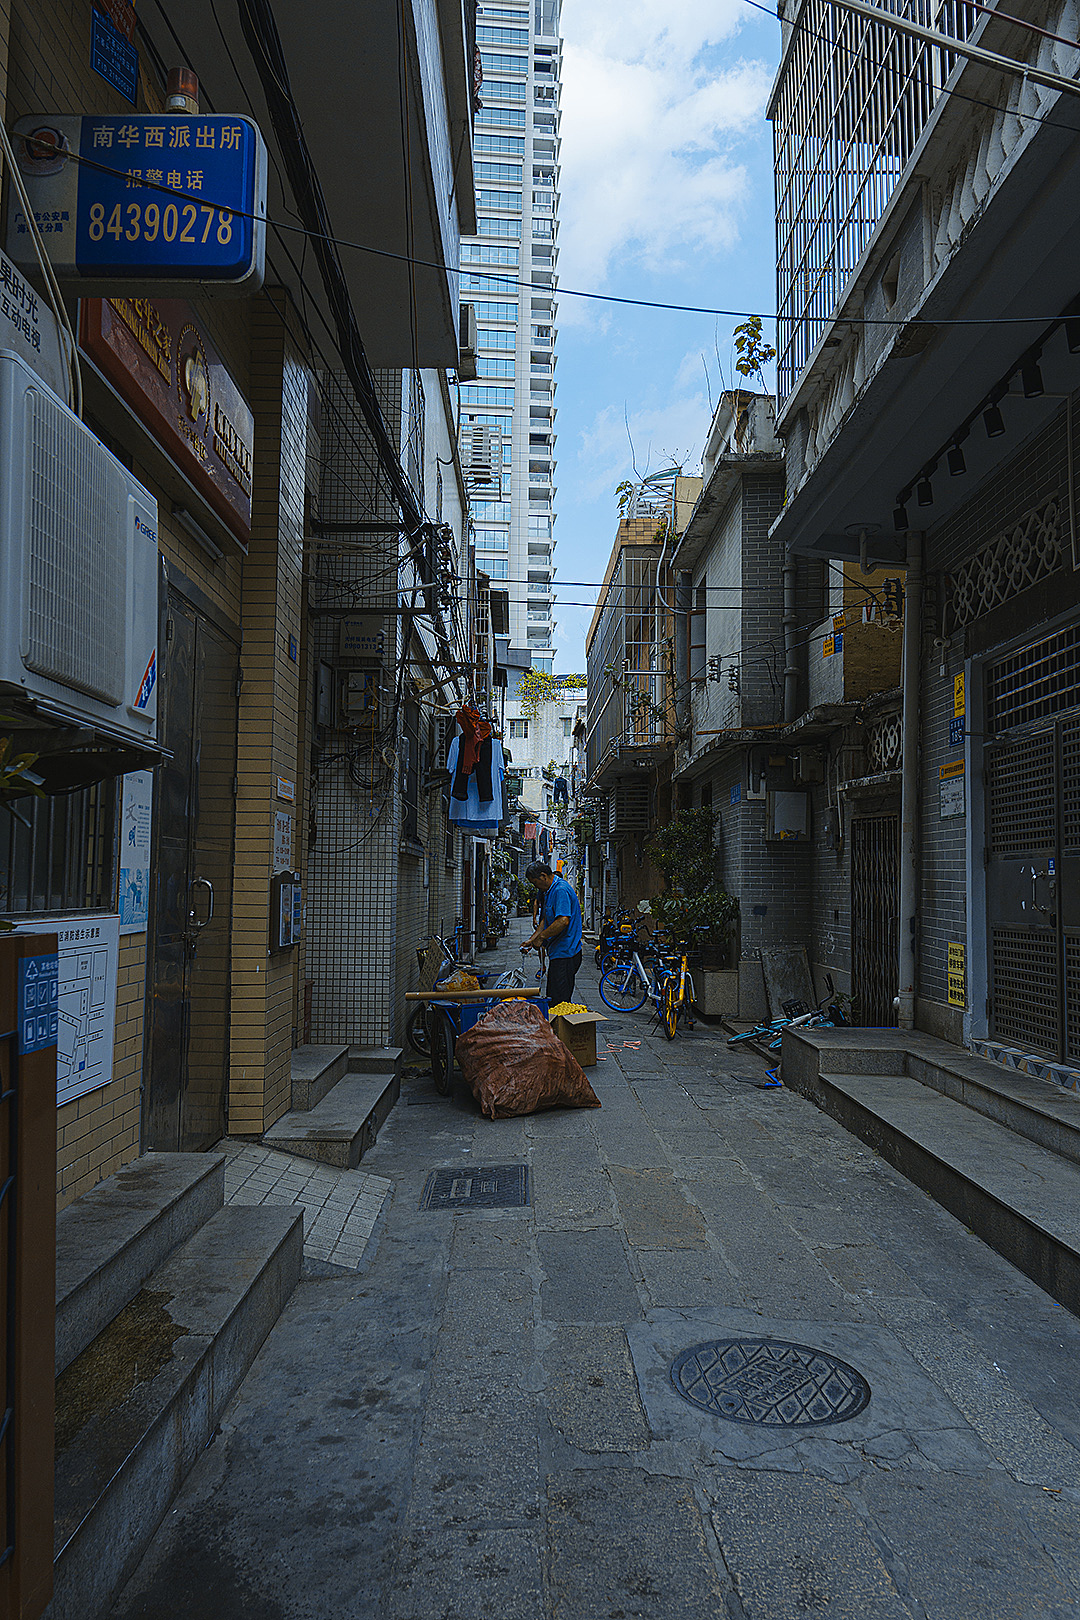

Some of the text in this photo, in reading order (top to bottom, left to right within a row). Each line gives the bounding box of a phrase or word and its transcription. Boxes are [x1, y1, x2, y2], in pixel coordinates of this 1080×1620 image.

[92, 125, 242, 150] 南华西派出所
[125, 168, 204, 190] 报警电话
[15, 211, 69, 222] 广市公安局
[88, 203, 234, 245] 84390278
[0, 257, 38, 324] 果时光
[1, 293, 40, 353] 互动电视
[141, 522, 157, 543] GREE
